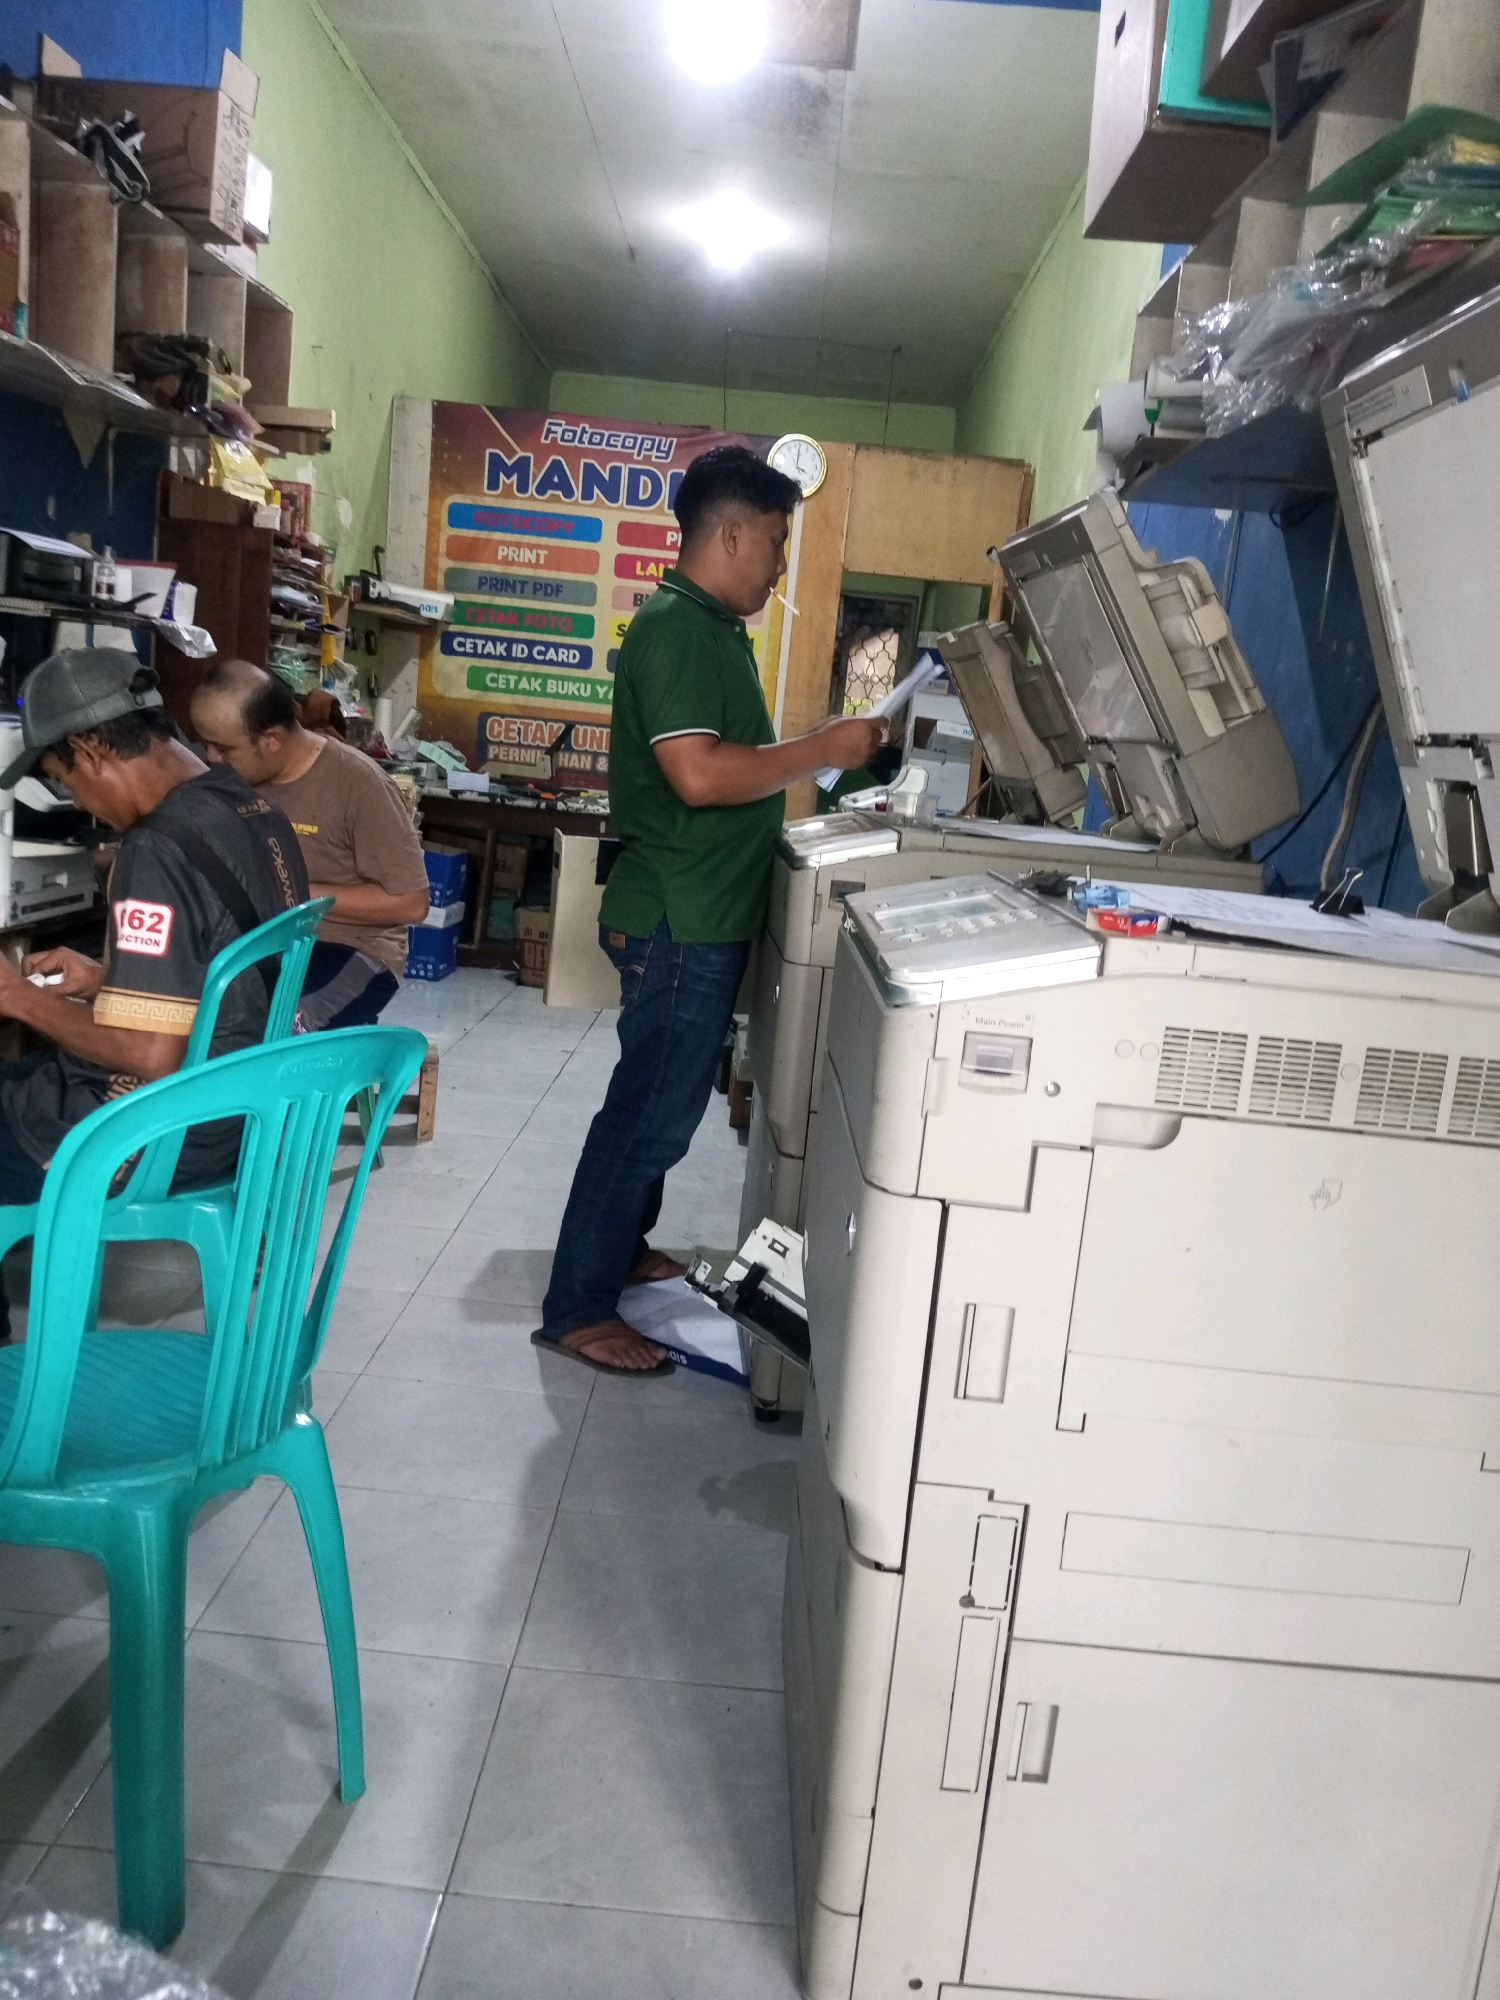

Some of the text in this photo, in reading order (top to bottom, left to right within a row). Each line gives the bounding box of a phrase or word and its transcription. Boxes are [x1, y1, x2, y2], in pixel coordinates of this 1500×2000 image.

[541, 419, 677, 463] Fotocopy
[474, 510, 576, 535] FOTOCOPY
[497, 545, 549, 565] PRINT
[477, 575, 564, 599] PRINT PDF
[465, 607, 574, 632] CETAK FOTO
[452, 636, 581, 664] CETAK ID CARD
[485, 672, 543, 692] CETAK
[546, 678, 592, 698] BUKU
[486, 716, 566, 747] CETAK
[975, 1017, 1025, 1029] Main Power
